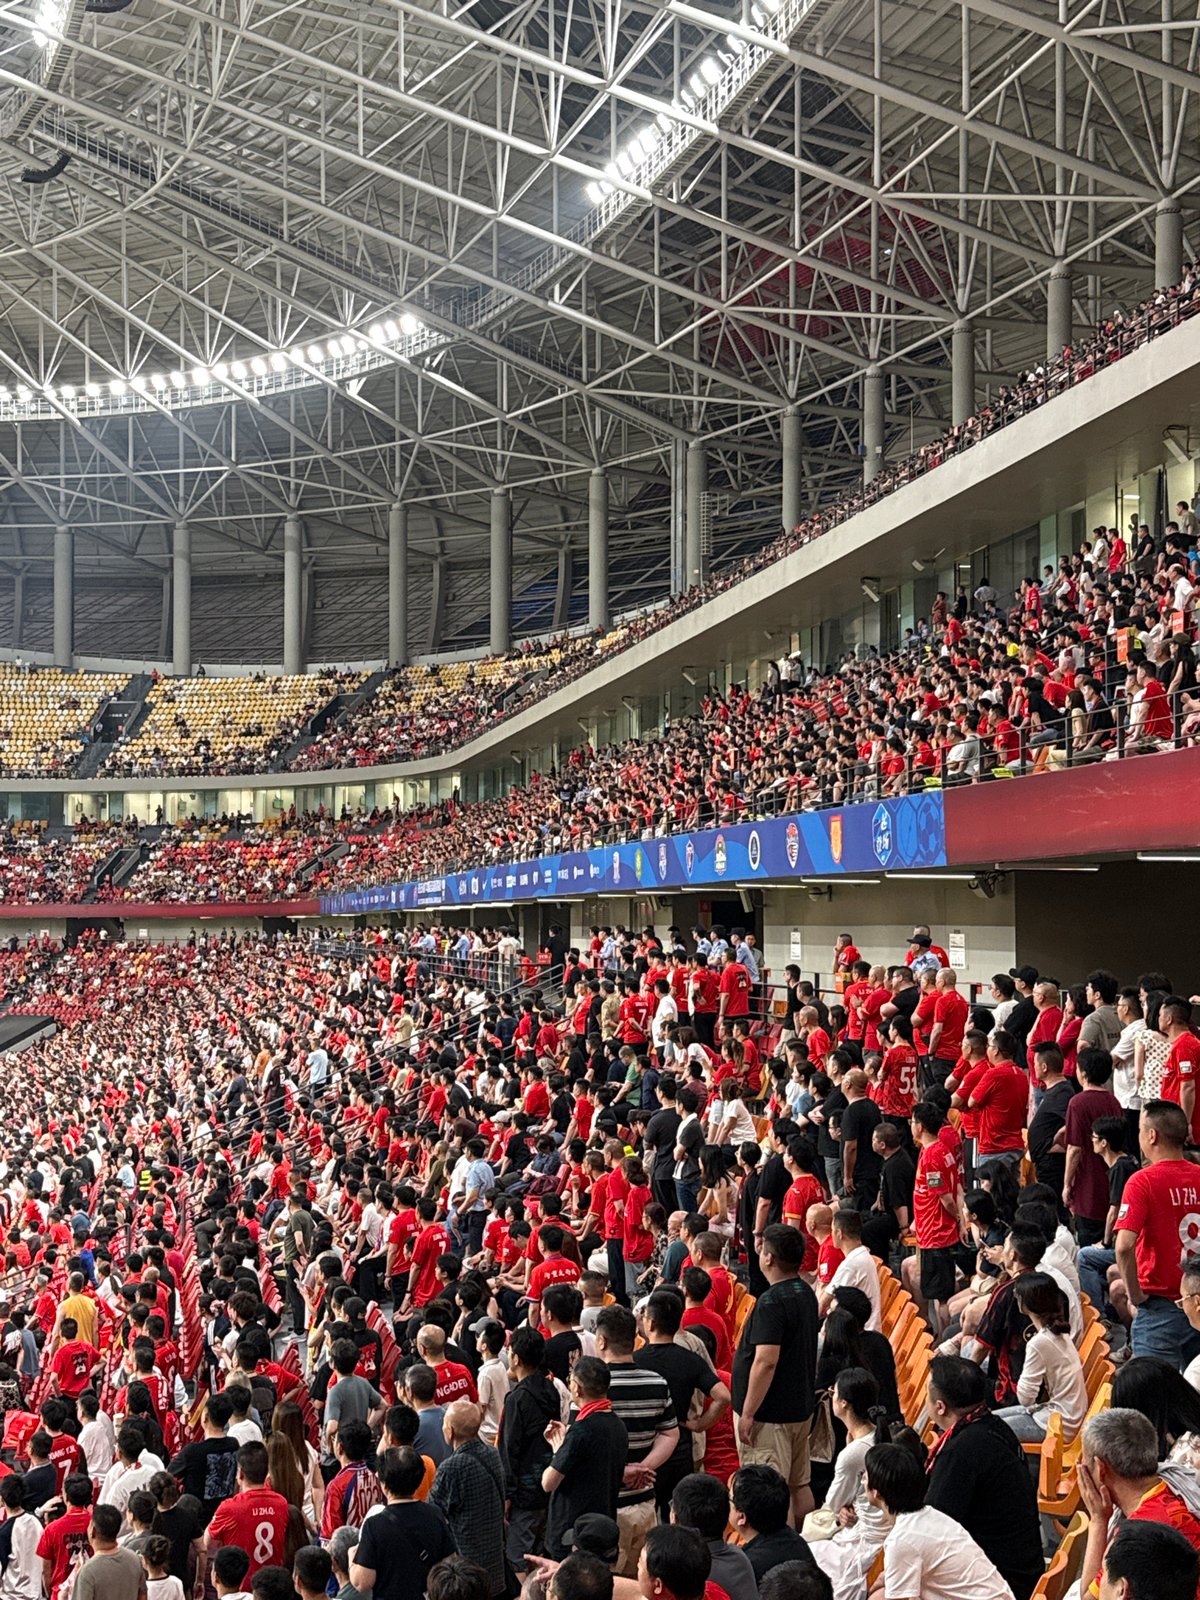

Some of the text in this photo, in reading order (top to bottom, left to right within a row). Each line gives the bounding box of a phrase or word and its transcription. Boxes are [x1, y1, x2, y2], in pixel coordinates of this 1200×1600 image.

[638, 1009, 647, 1027] 7
[1168, 1187, 1181, 1206] LI
[58, 1459, 72, 1490] 7
[254, 1521, 274, 1564] 8
